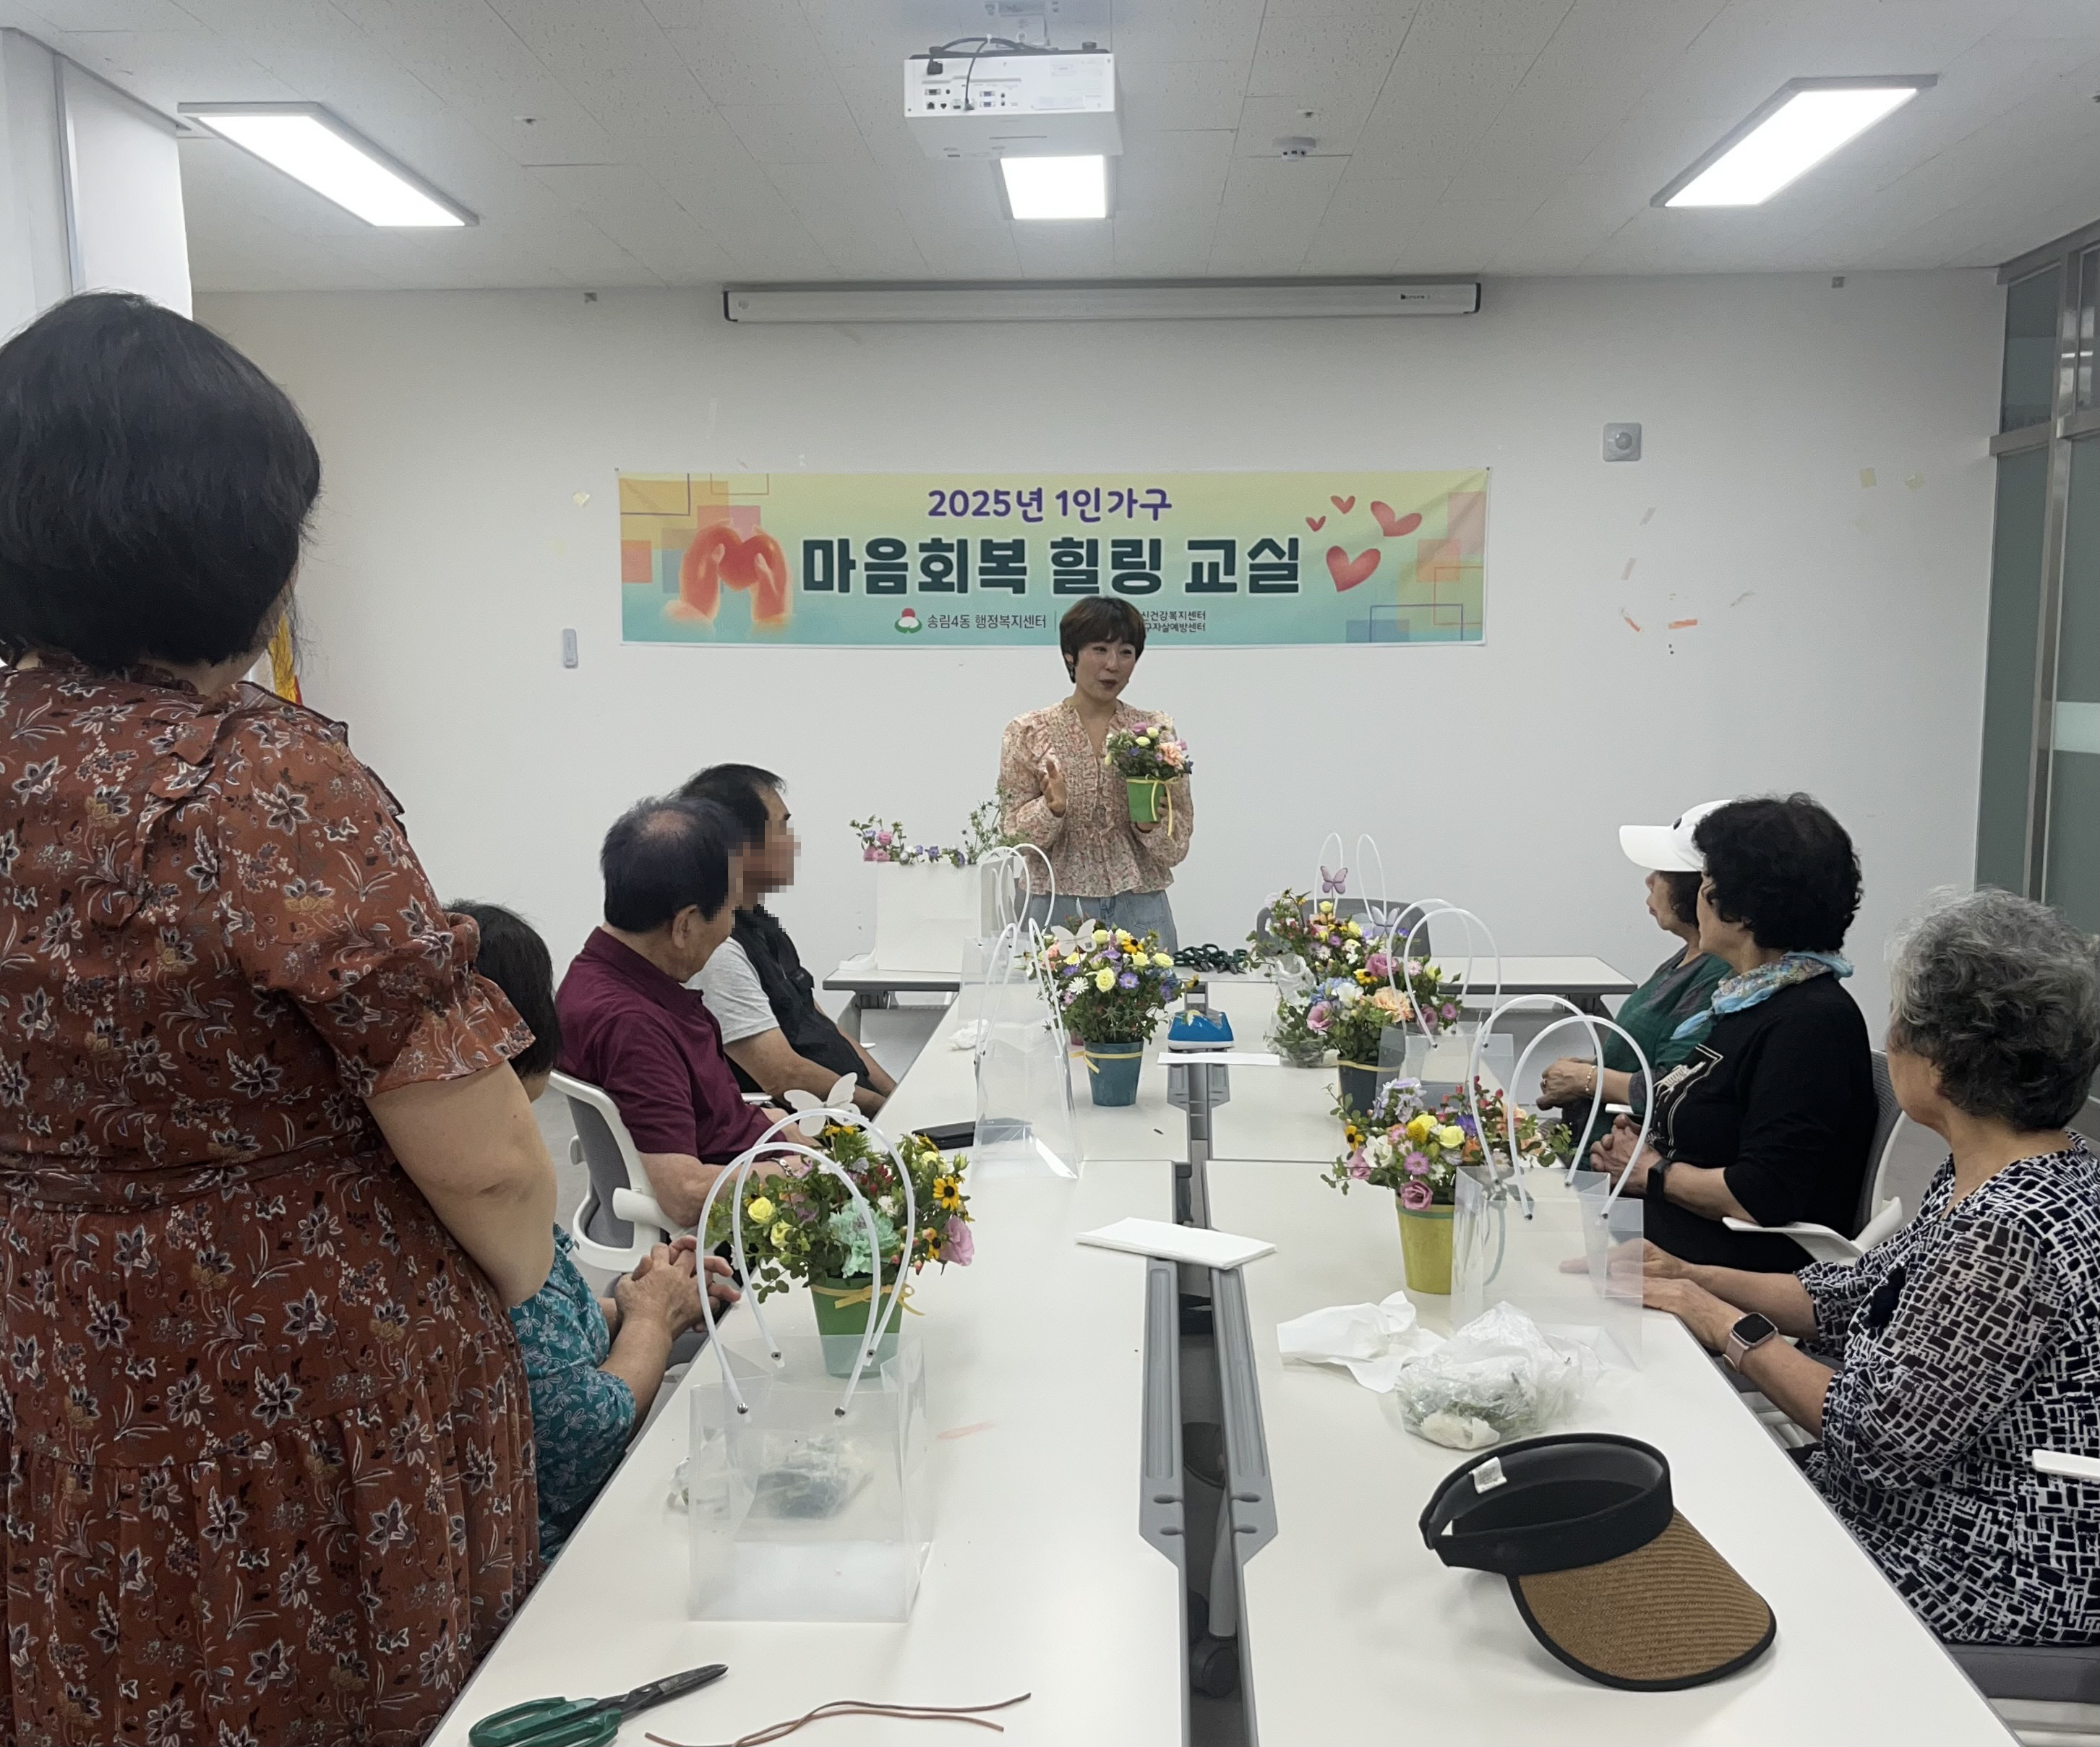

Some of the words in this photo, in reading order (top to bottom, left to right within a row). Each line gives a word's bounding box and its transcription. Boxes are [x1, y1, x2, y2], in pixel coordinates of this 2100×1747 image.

[928, 487, 1044, 523] 2025년
[1055, 486, 1173, 523] 1인가구
[803, 537, 1027, 595] 마음회복
[1050, 537, 1162, 595] 힐링
[1185, 537, 1299, 594] 교실
[927, 614, 970, 629] 송림4동
[975, 614, 1046, 629] 행정복지센터
